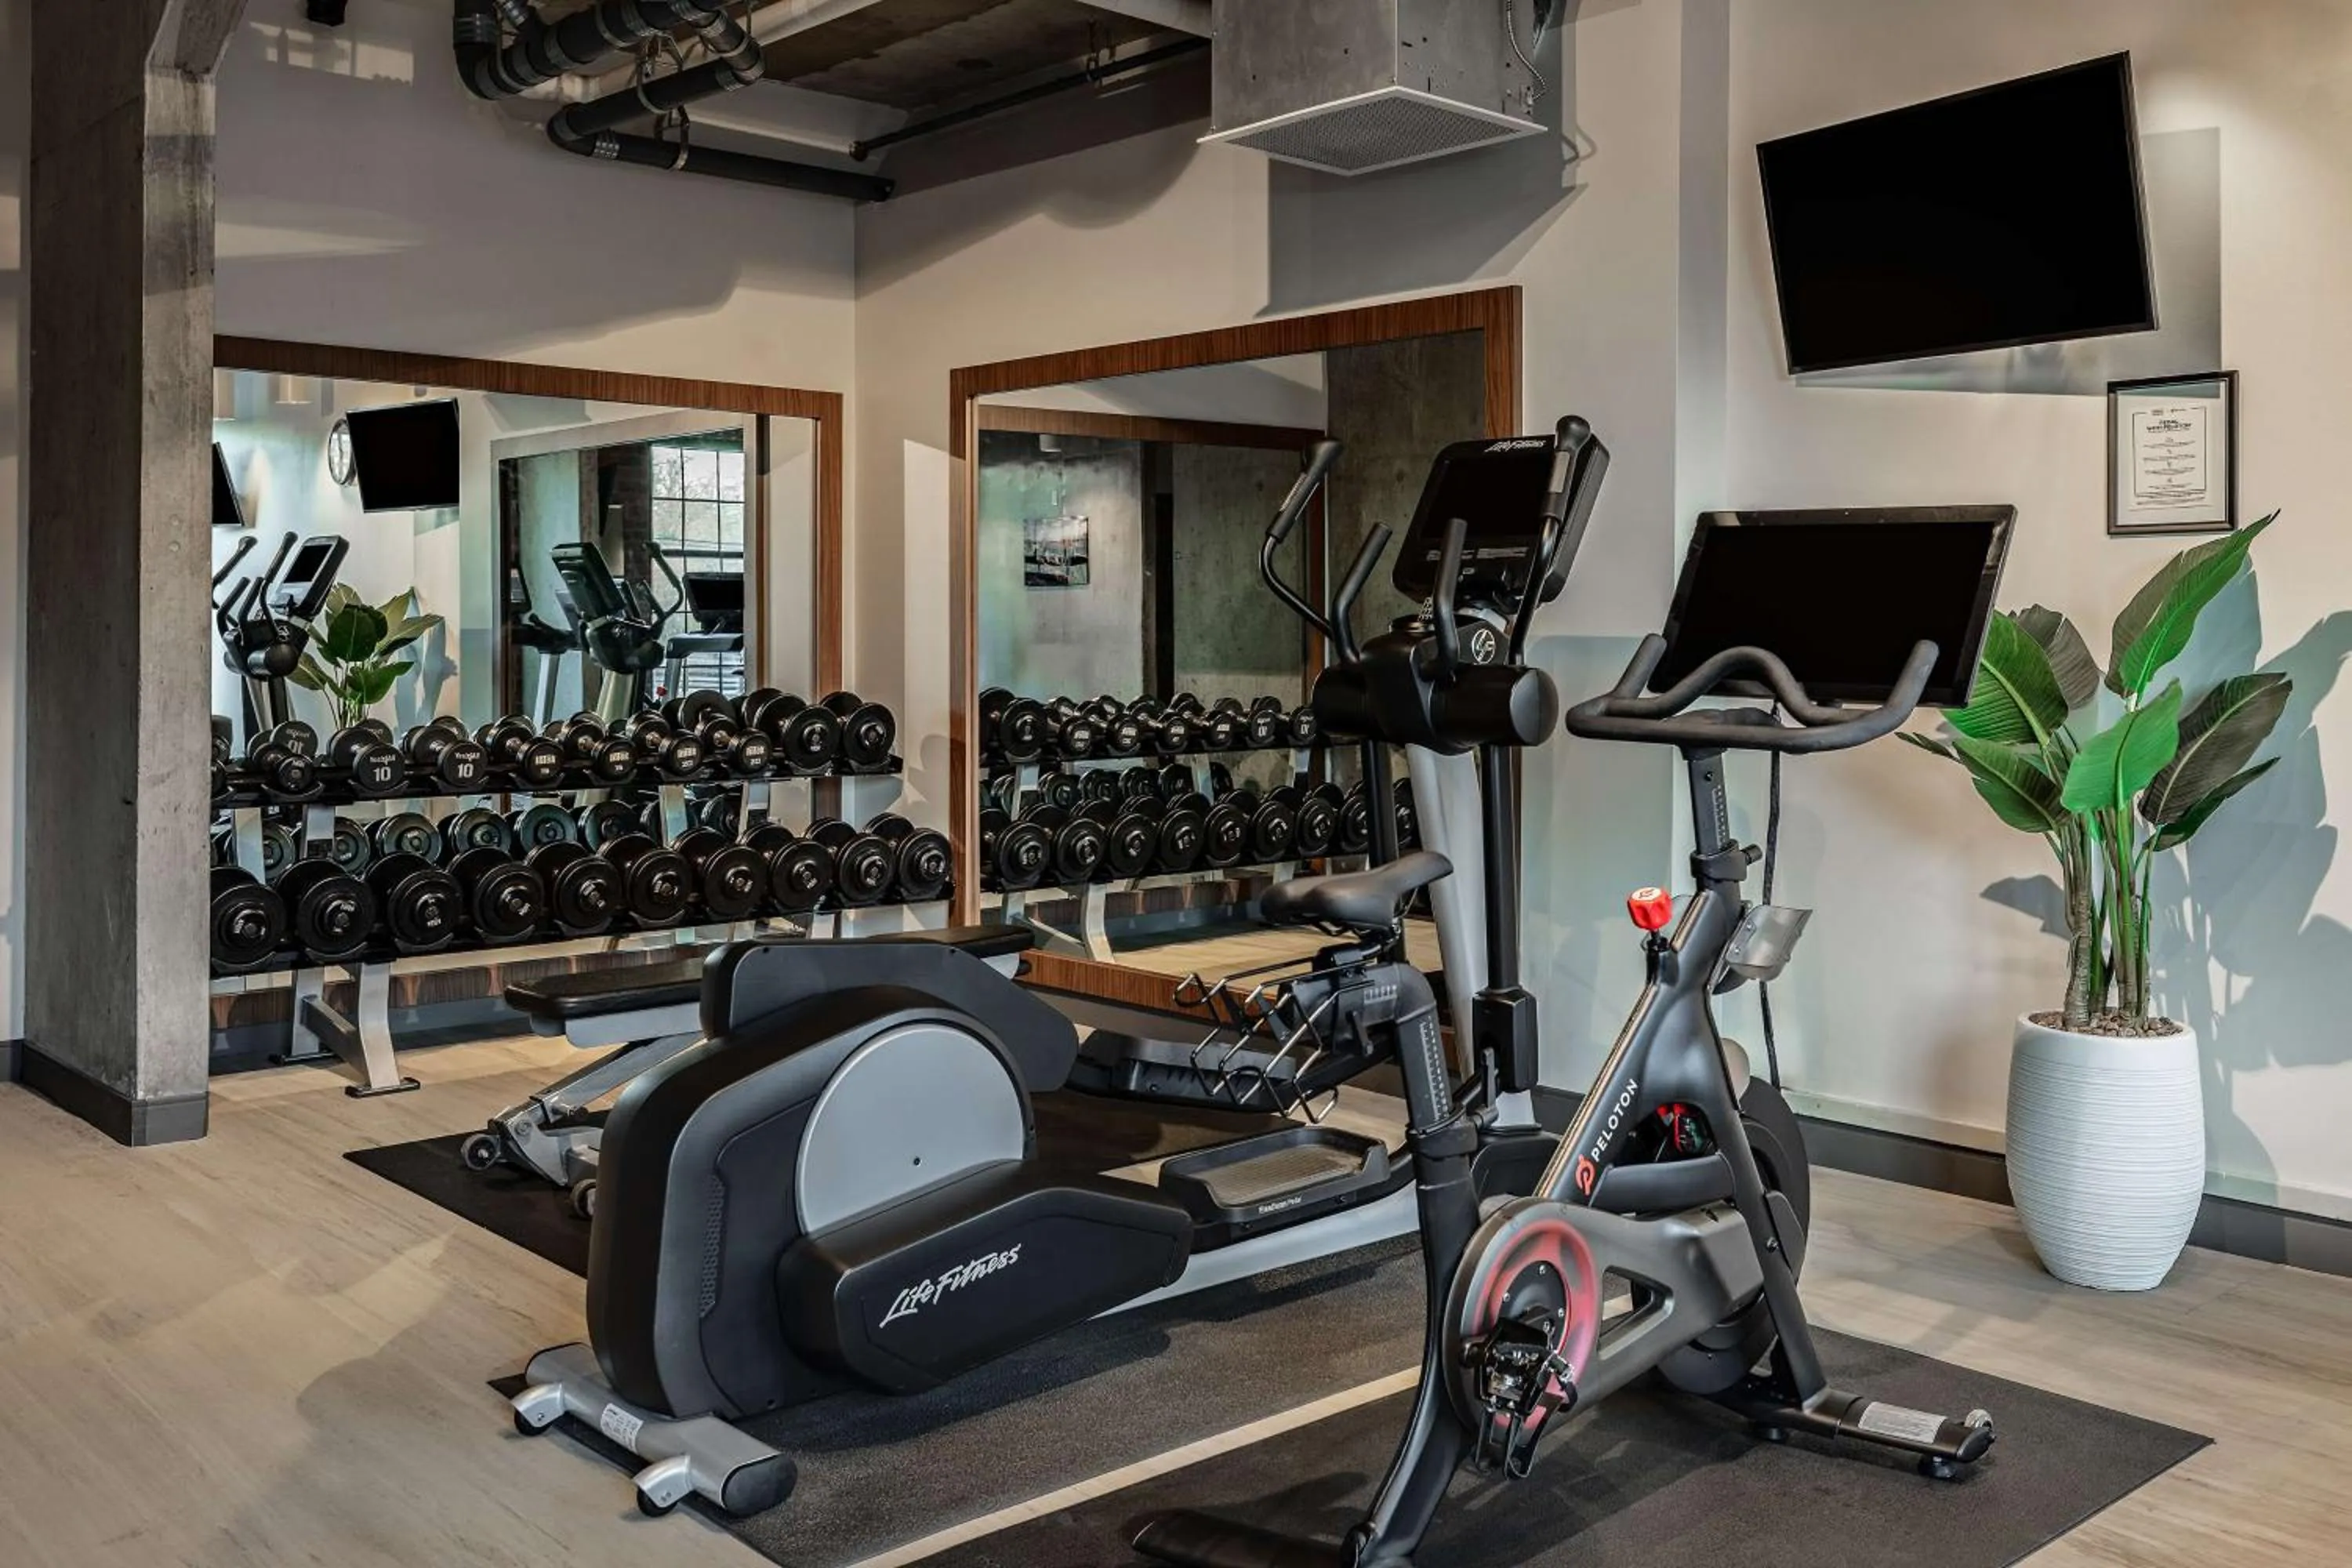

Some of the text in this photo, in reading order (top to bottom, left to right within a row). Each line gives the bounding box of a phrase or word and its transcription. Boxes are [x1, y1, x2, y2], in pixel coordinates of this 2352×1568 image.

[372, 766, 391, 782] 10
[457, 763, 474, 779] 10
[1591, 1078, 1639, 1163] PELOTON
[879, 1243, 1022, 1328] Life Fitness
